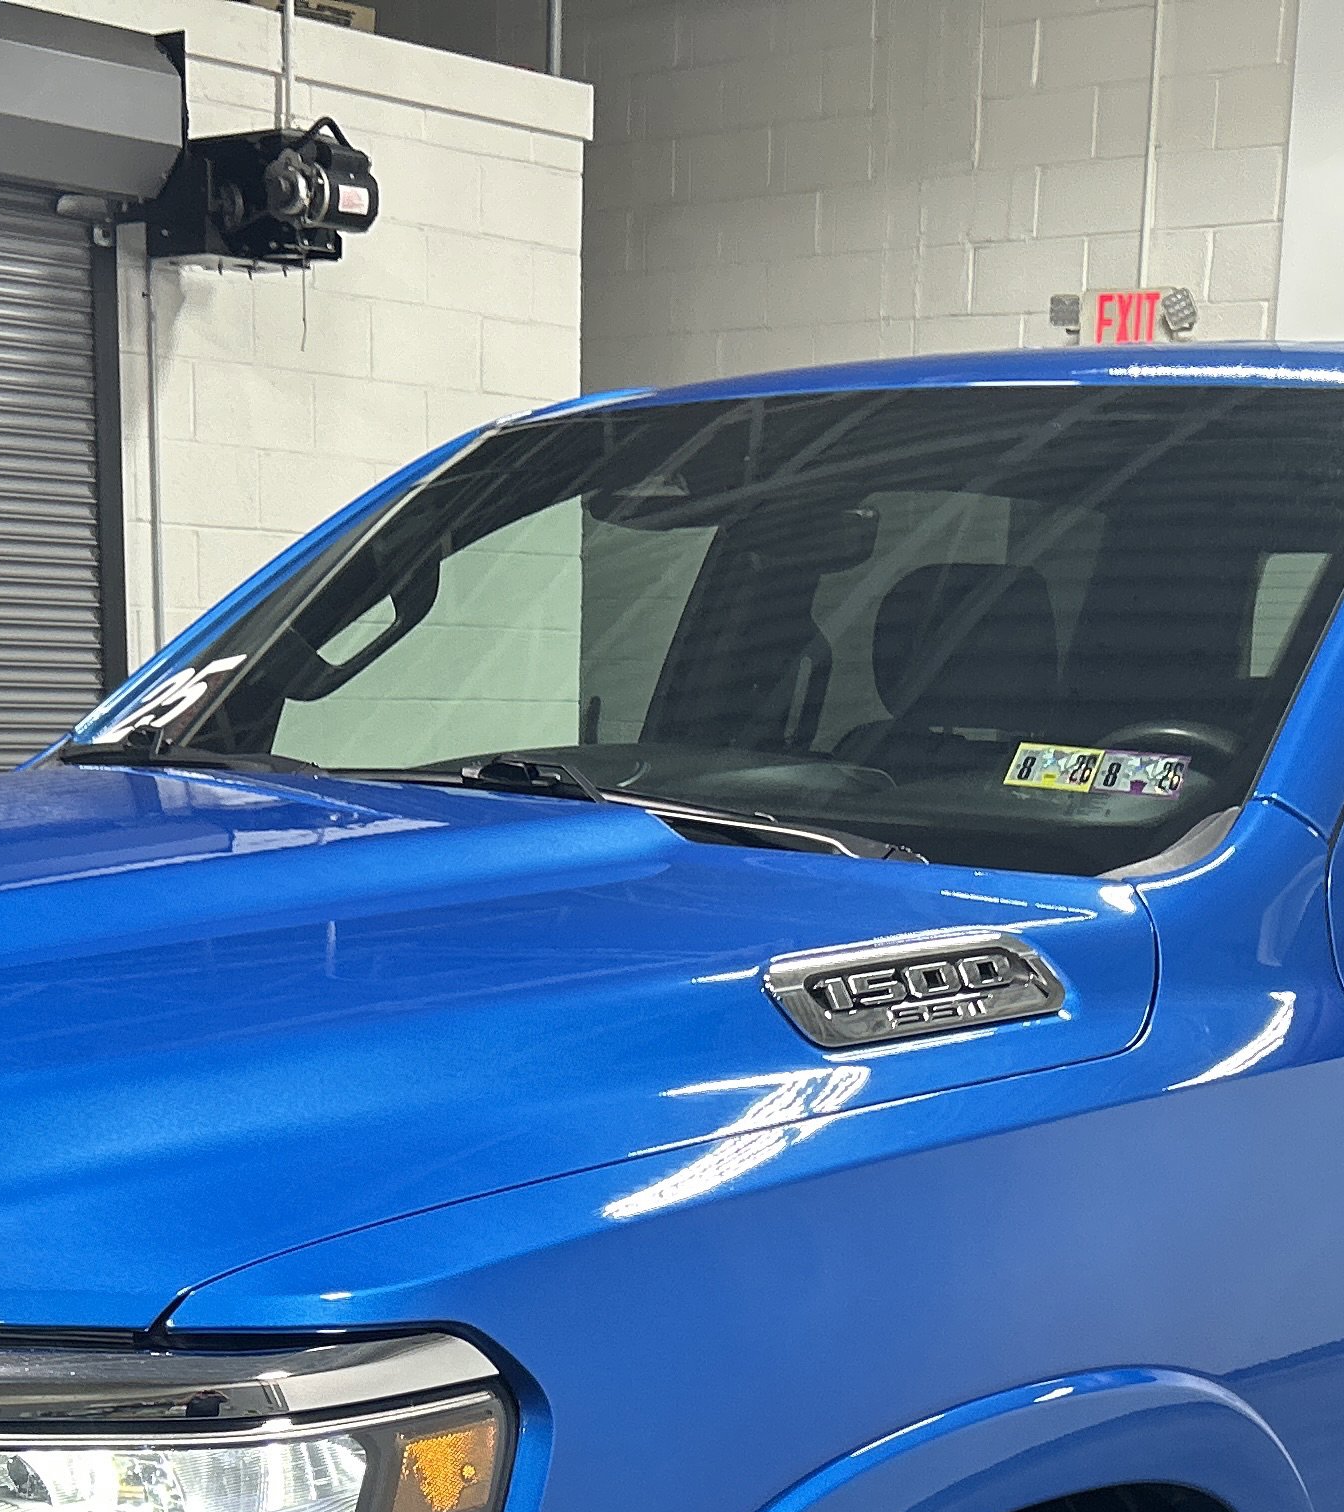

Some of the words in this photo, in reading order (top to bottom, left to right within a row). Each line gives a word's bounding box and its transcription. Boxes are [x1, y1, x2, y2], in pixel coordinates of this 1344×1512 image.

[1096, 292, 1160, 345] EXIT
[1017, 756, 1037, 780] 8
[1069, 754, 1098, 785] 26
[1102, 762, 1122, 787] 8
[1158, 761, 1185, 791] 26
[813, 955, 1010, 1013] 1500
